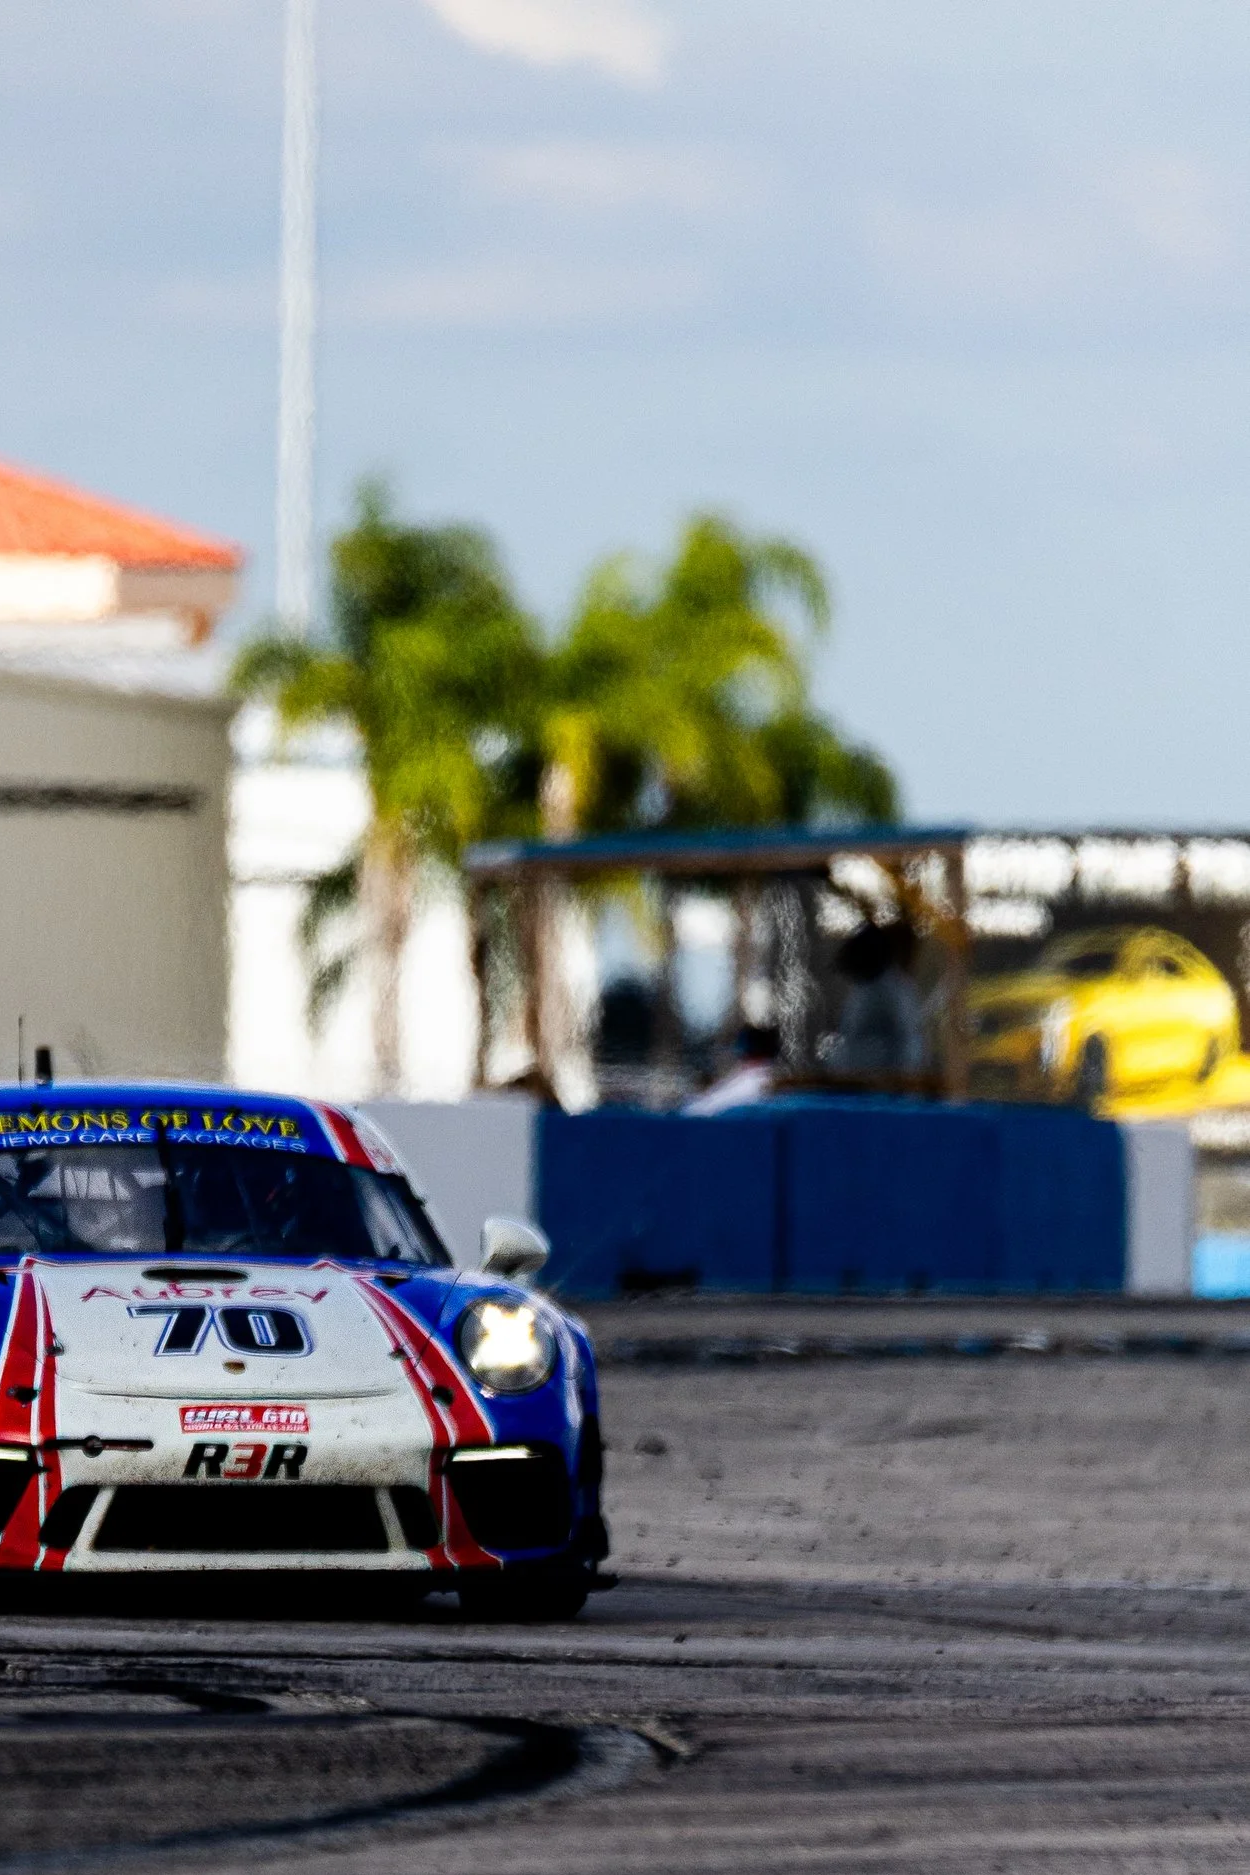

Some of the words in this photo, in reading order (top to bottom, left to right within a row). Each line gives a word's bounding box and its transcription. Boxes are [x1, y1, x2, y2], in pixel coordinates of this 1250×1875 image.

[78, 1132, 151, 1144] CARE
[140, 1110, 188, 1131] OF
[201, 1112, 300, 1139] LOVE
[80, 1280, 329, 1304] Aubrey
[126, 1303, 315, 1358] 70
[181, 1441, 309, 1480] R3R
